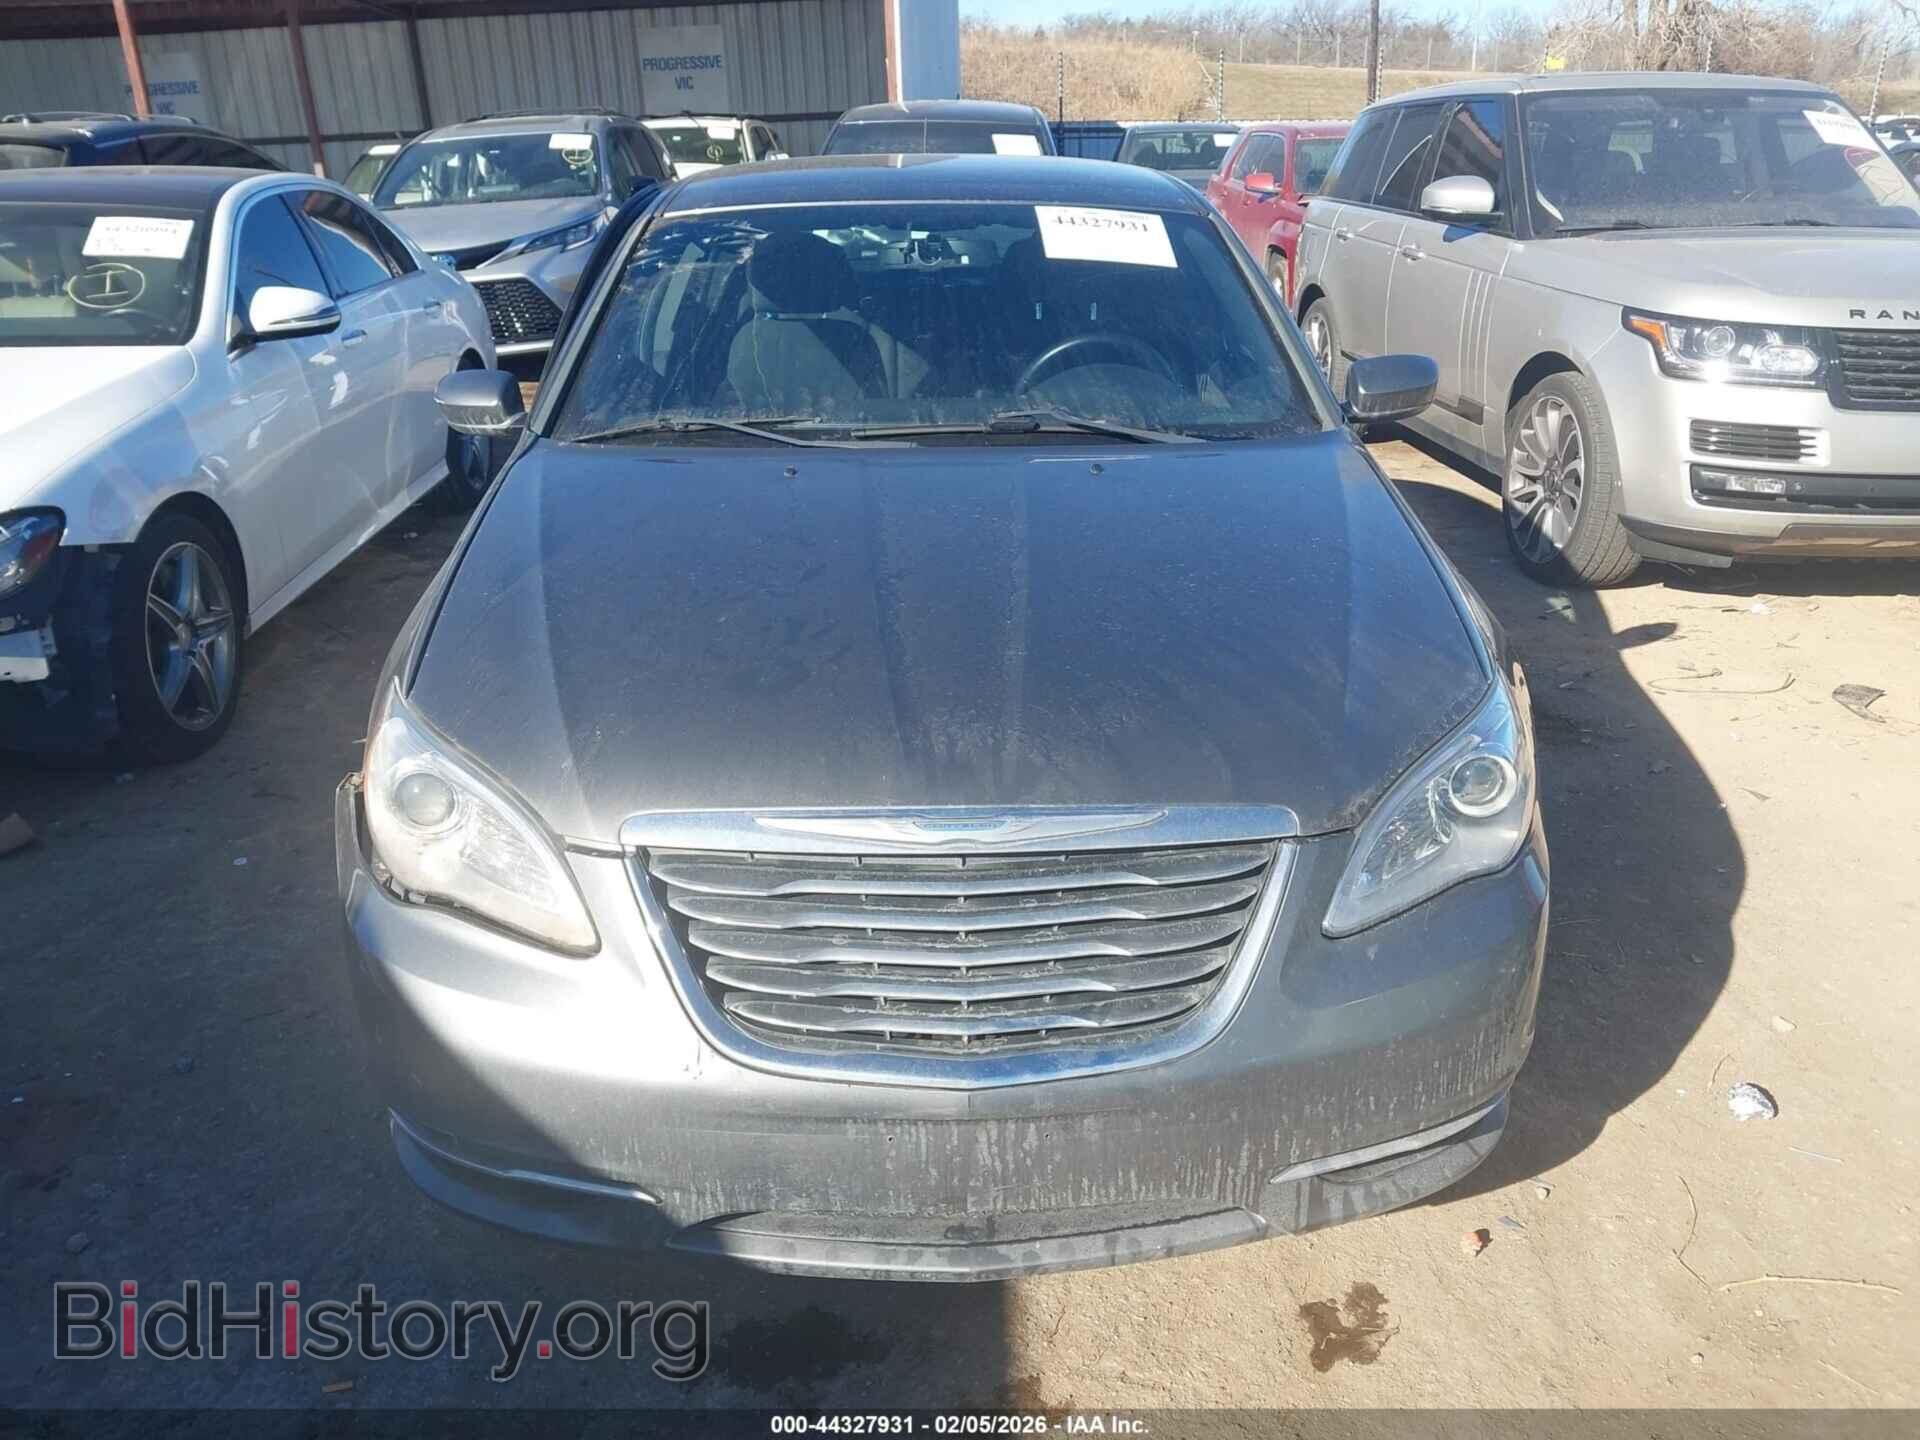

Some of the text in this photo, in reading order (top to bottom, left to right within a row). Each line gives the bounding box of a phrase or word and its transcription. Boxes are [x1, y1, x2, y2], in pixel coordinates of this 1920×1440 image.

[642, 55, 722, 71] PROGRESSIVE
[674, 76, 694, 90] VIC
[1053, 216, 1149, 232] 44327931
